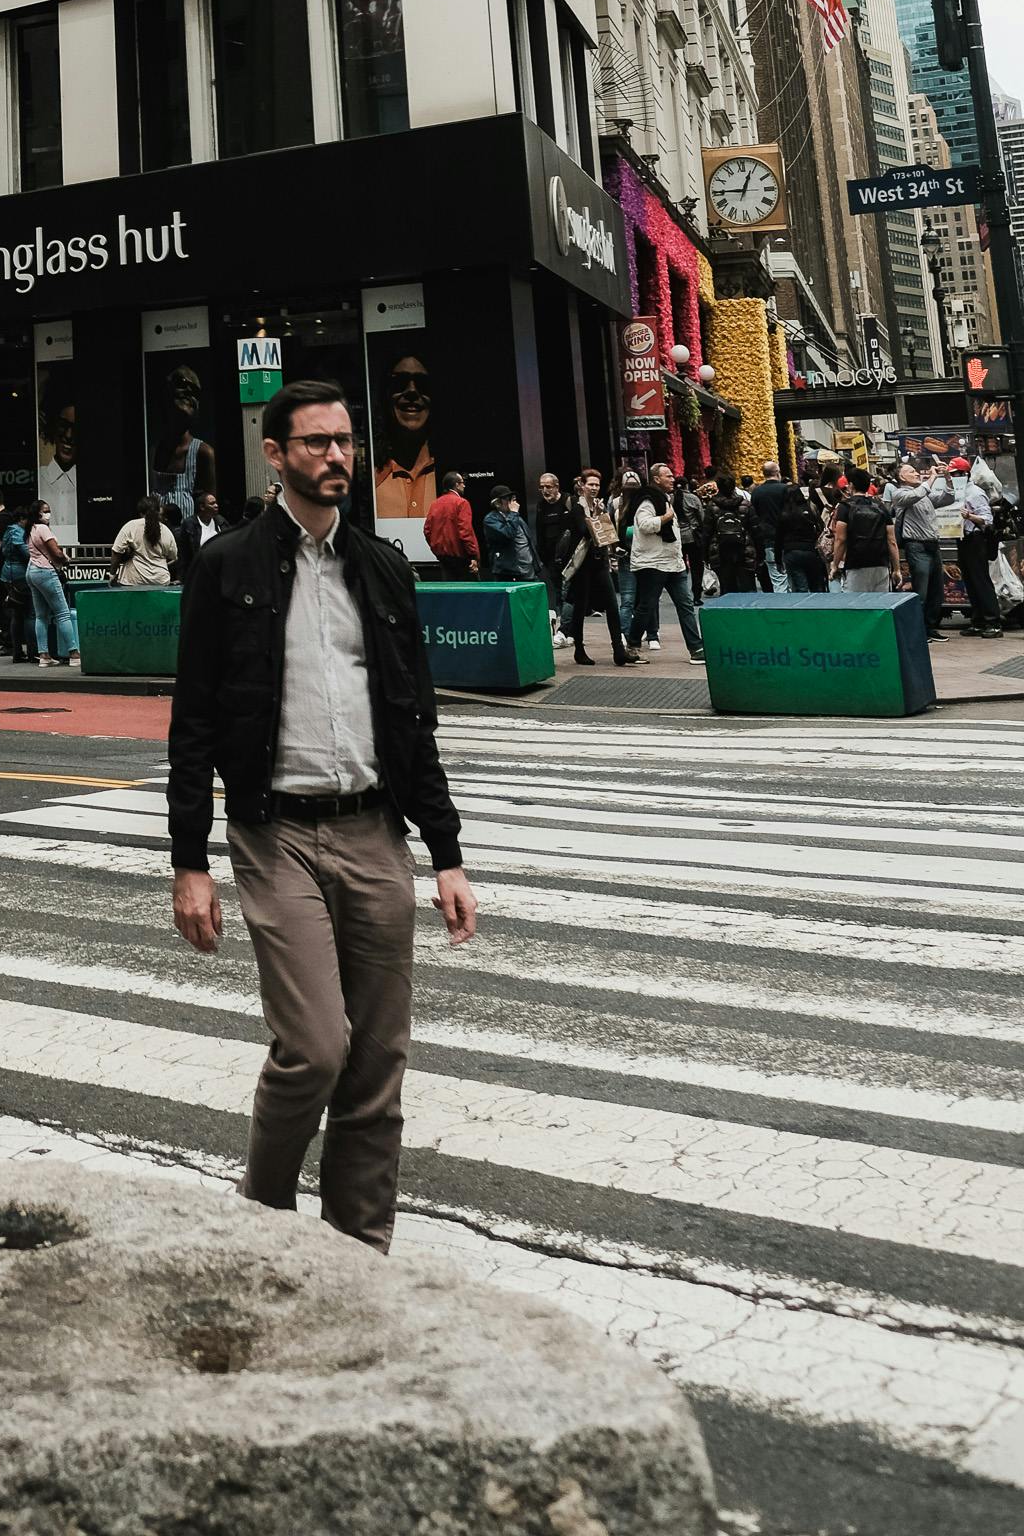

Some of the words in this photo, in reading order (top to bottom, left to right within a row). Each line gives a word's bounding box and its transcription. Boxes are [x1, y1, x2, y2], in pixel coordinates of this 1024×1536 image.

[858, 185, 905, 205] West
[907, 178, 940, 200] 34th
[945, 177, 965, 195] St
[118, 211, 189, 266] hut
[627, 333, 651, 349] KING
[625, 357, 656, 370] NOW
[624, 369, 660, 383] OPEN
[436, 626, 498, 649] Square
[719, 646, 791, 667] Herald
[798, 648, 881, 672] Square
